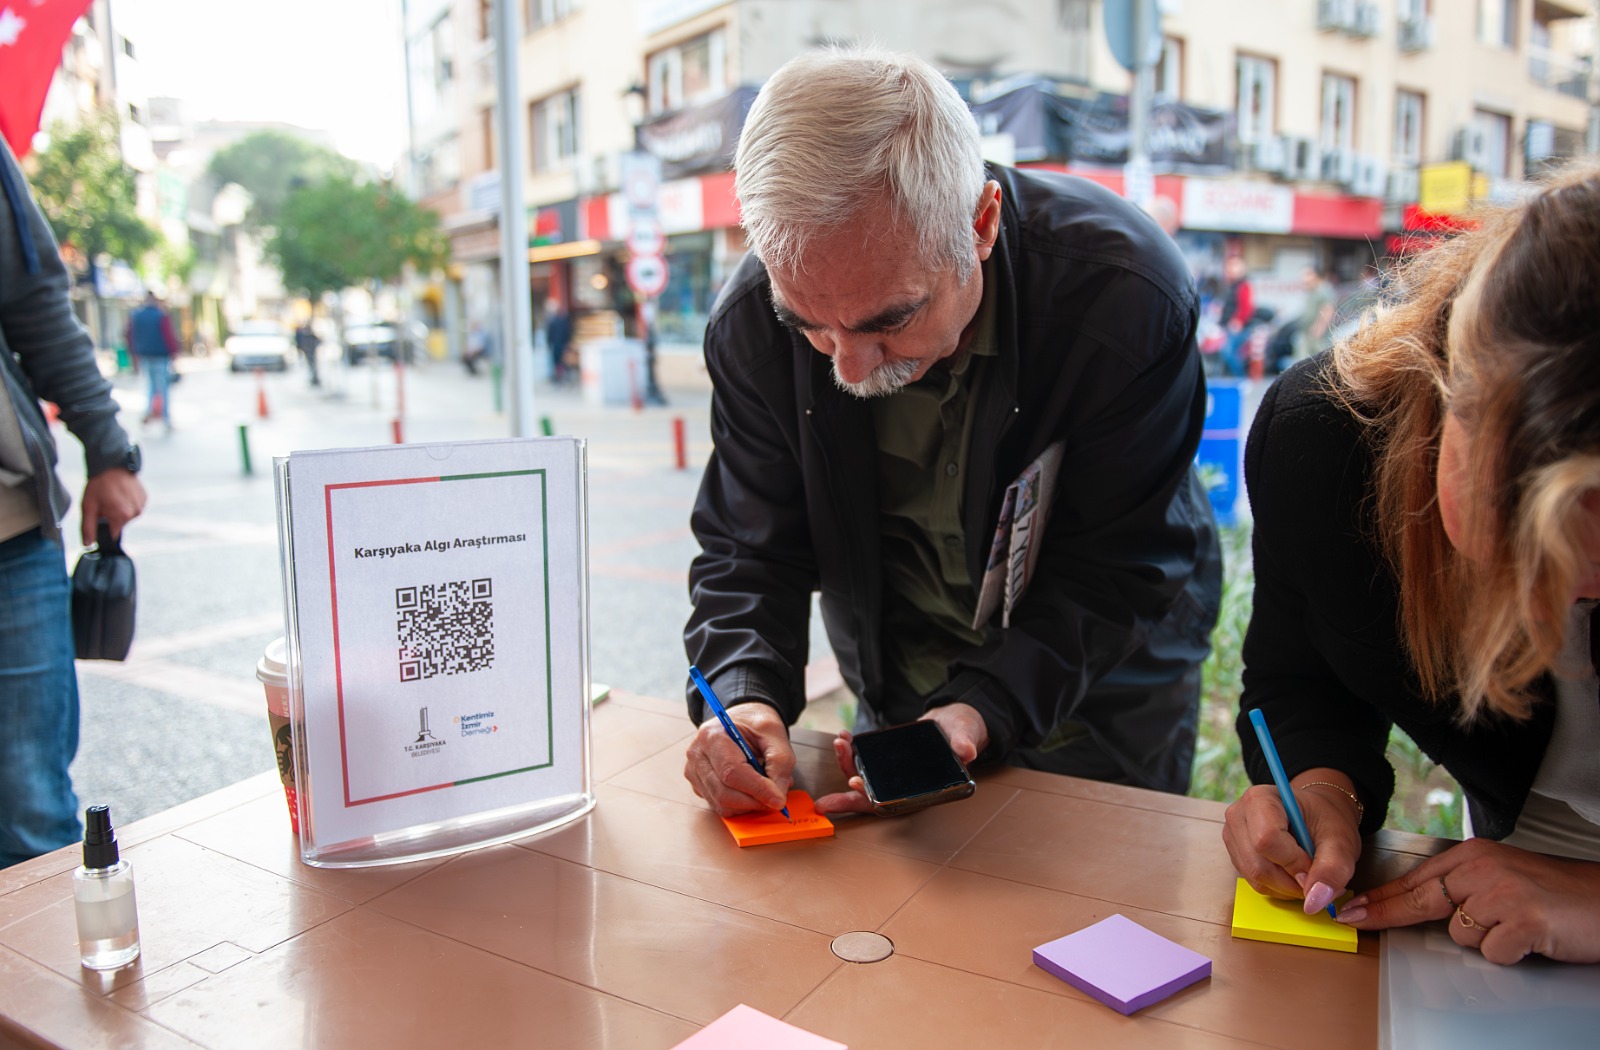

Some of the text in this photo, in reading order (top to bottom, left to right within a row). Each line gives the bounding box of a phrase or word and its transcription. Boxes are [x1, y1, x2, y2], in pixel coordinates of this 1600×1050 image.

[354, 533, 526, 558] Karşıyaka Algı Araştırması
[461, 711, 494, 722] Kentimiz
[461, 726, 492, 737] Derneği
[415, 740, 446, 750] KARŞIYAKA
[411, 748, 440, 758] BELEDİYESİ
